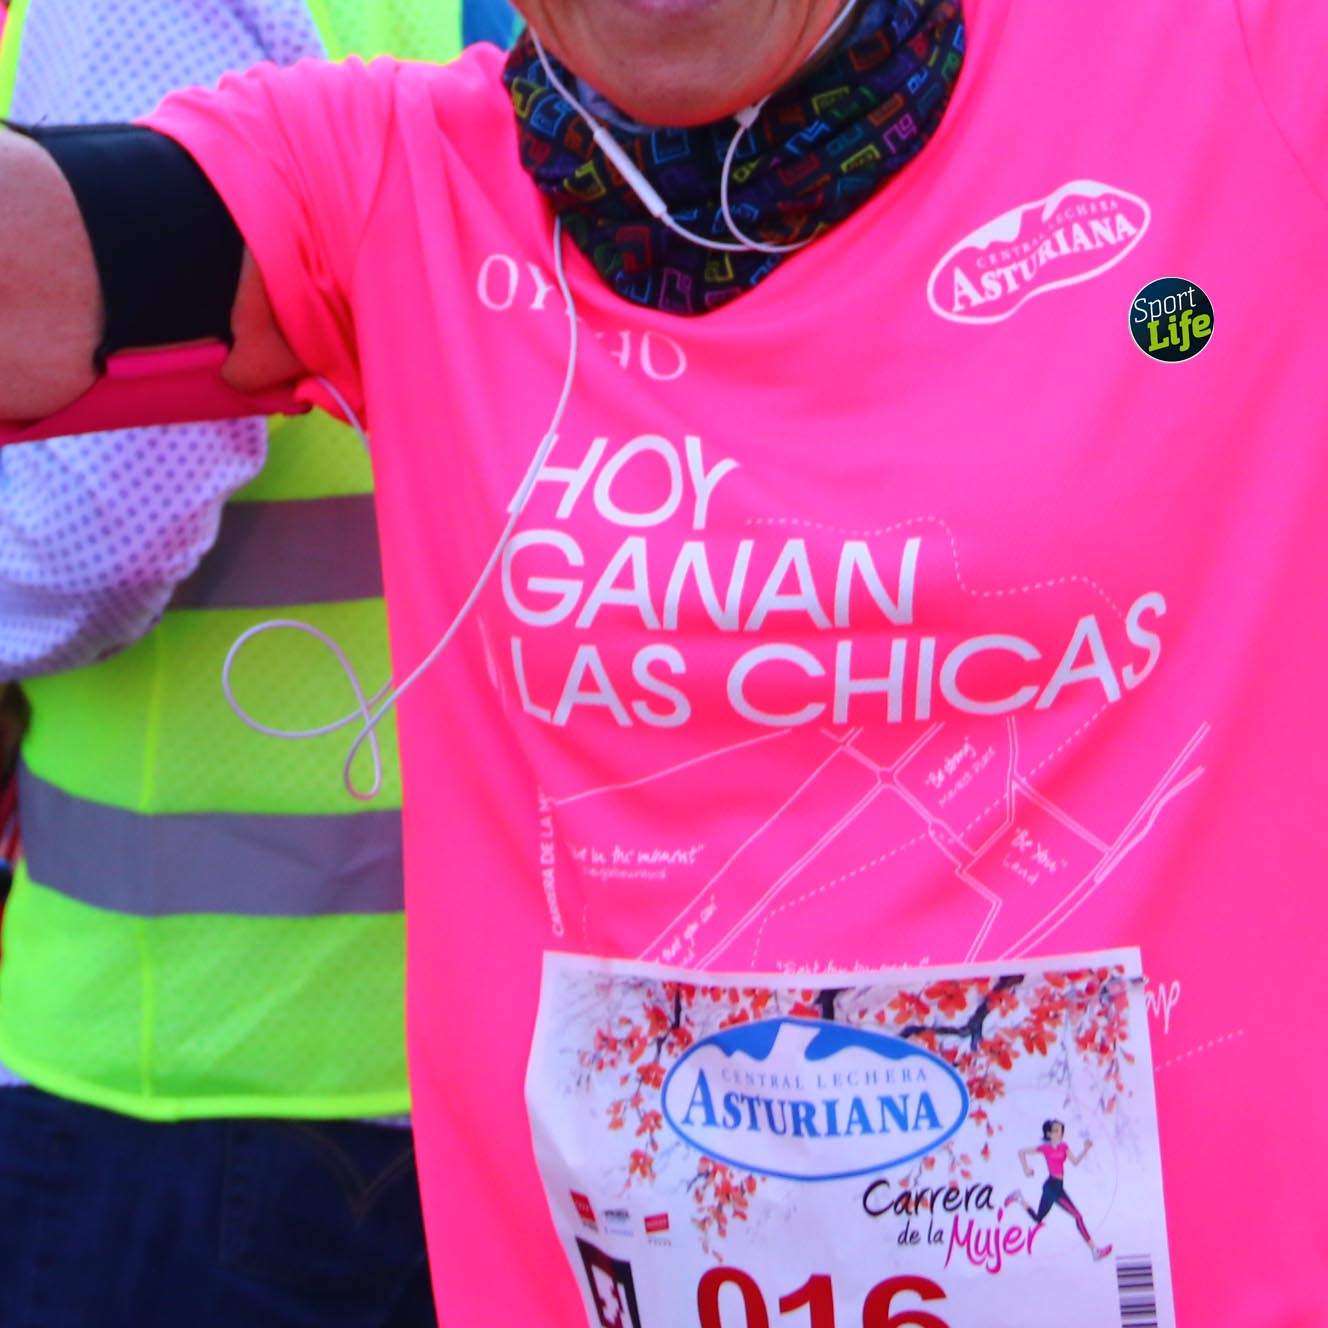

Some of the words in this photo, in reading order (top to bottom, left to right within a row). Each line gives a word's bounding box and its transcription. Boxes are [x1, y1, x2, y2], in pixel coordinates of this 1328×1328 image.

[951, 213, 1137, 313] ASTURIANA
[1133, 286, 1197, 324] Sport
[1147, 309, 1212, 352] Life
[507, 434, 740, 531] HOY
[501, 529, 921, 632] GANAN
[510, 635, 697, 727] LAS
[725, 592, 1167, 727] CHICAS
[683, 1068, 943, 1138] ASTURIANA
[722, 1070, 804, 1090] CENTRAL
[817, 1069, 928, 1089] LECHERA
[863, 1179, 994, 1217] Carrera
[897, 1221, 921, 1246] de
[927, 1222, 944, 1245] la
[944, 1208, 1046, 1275] Mujer
[697, 1266, 948, 1328] 016
